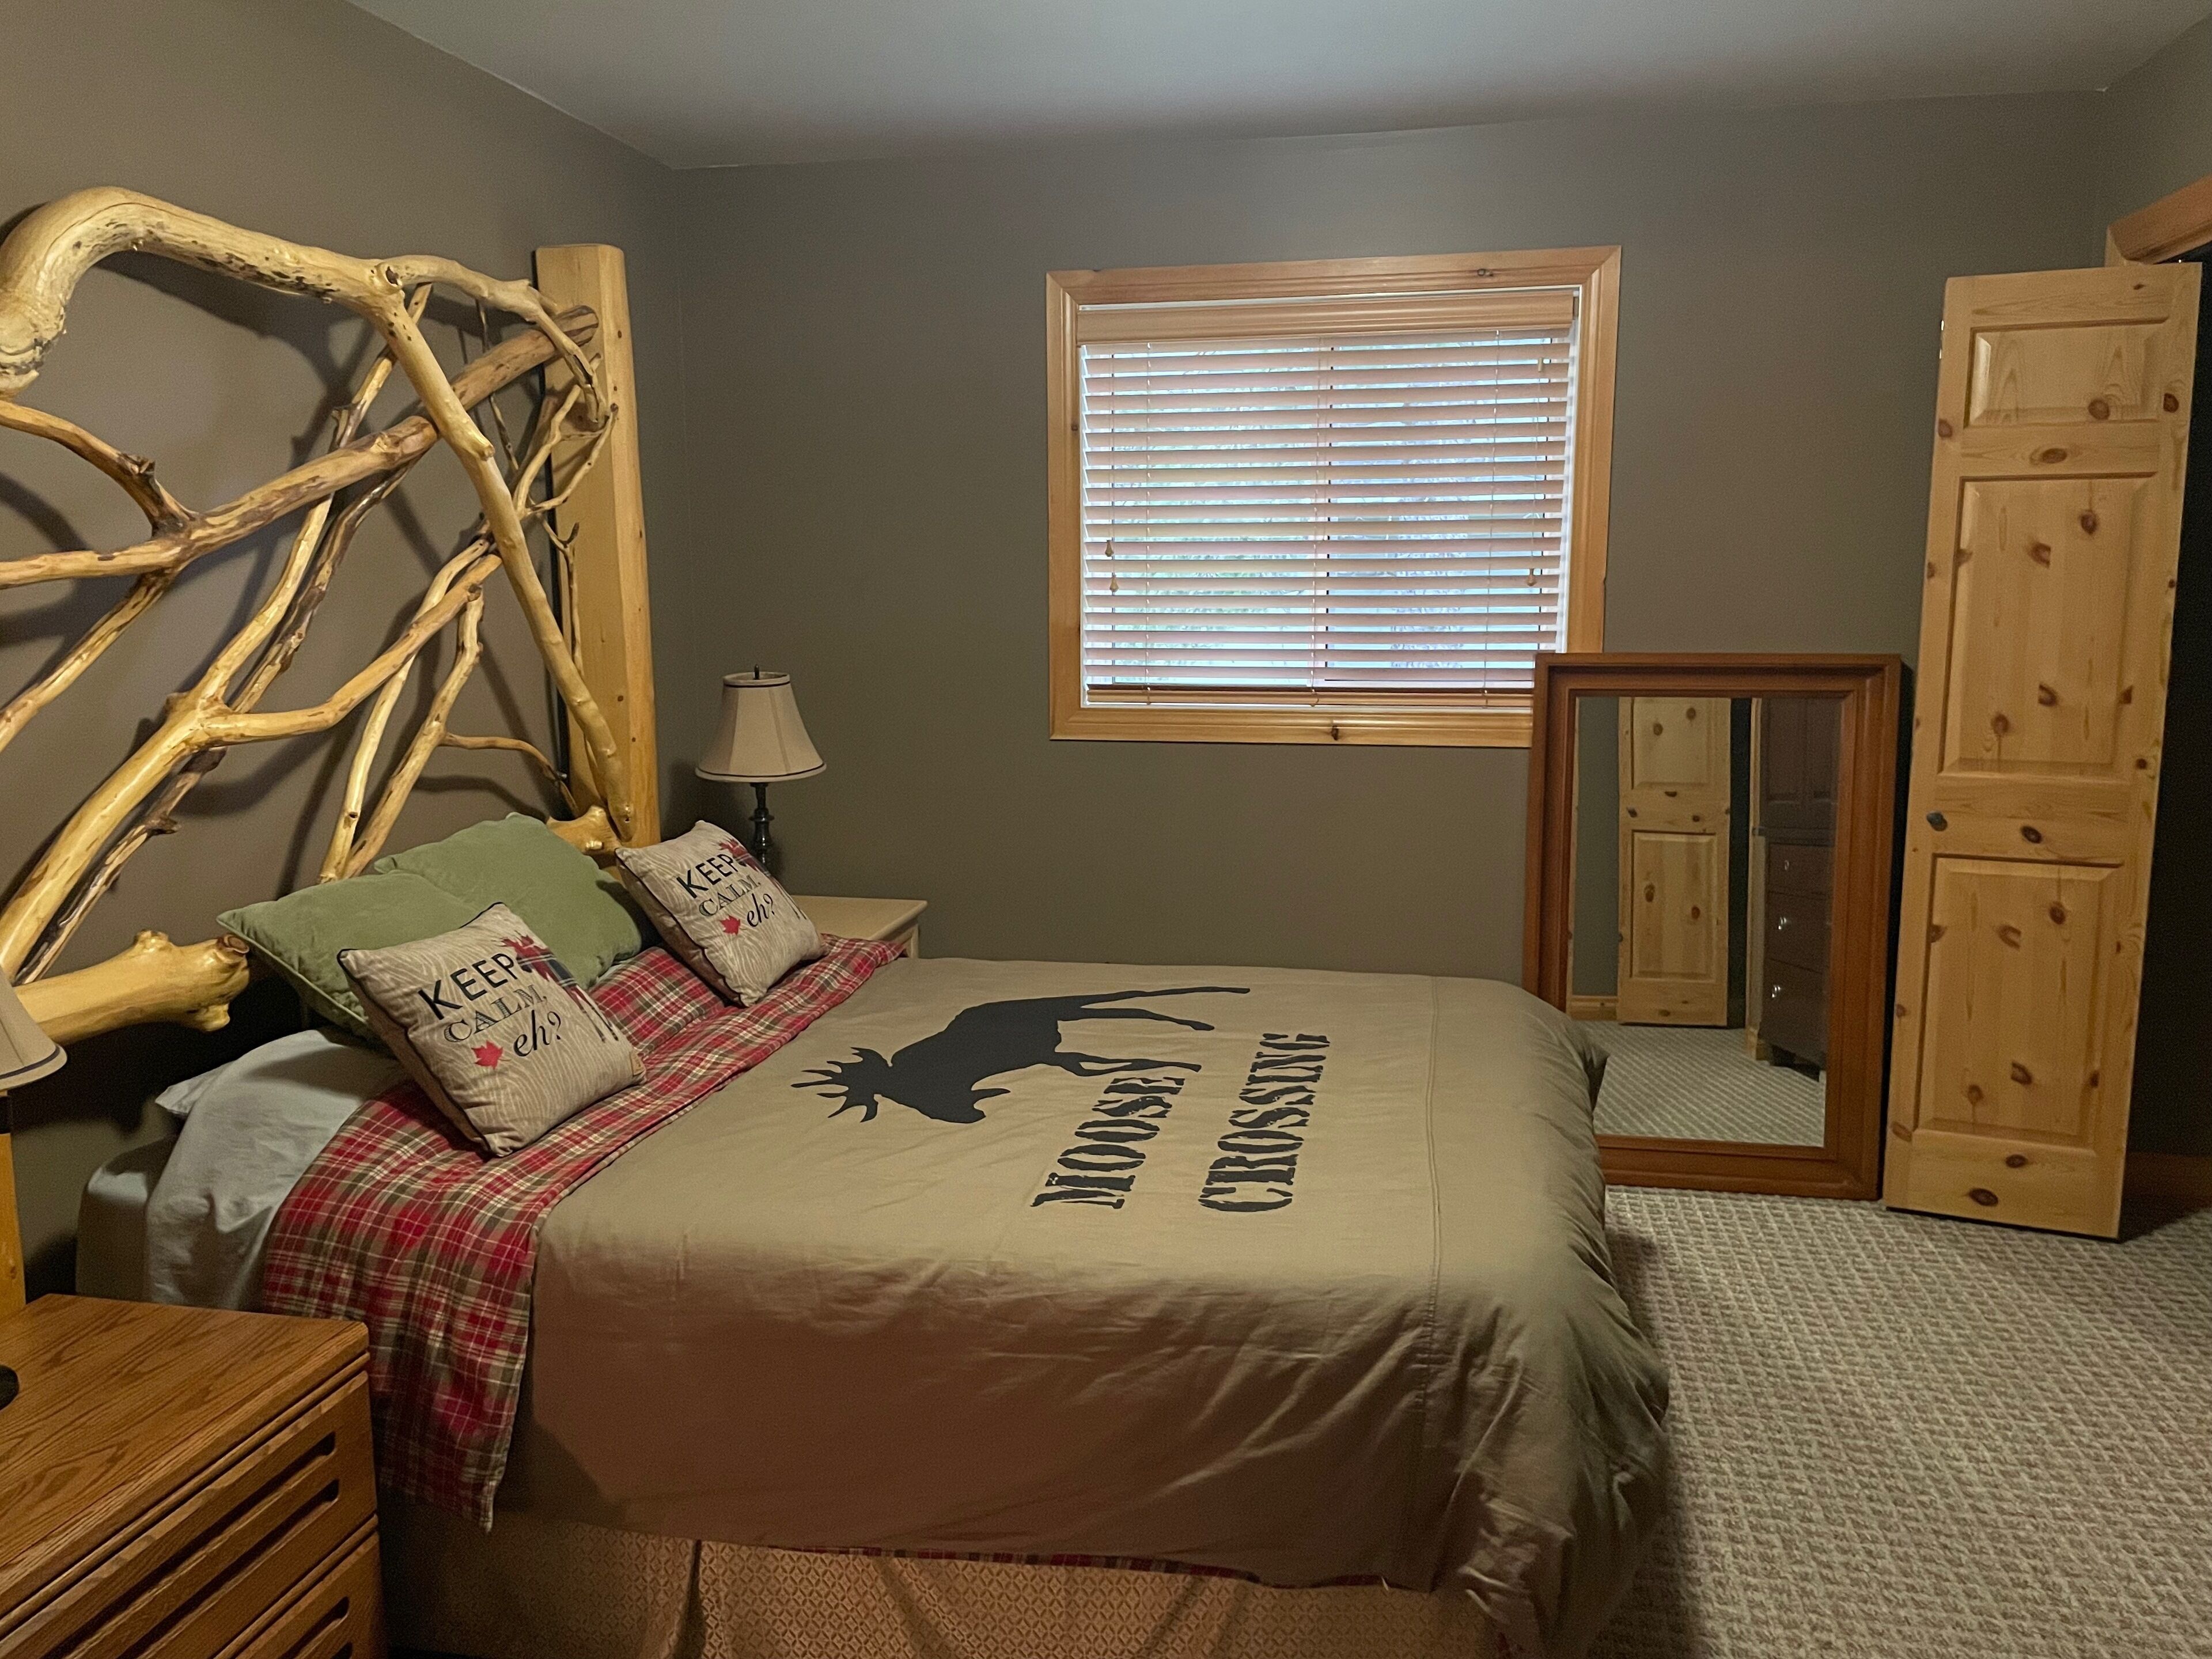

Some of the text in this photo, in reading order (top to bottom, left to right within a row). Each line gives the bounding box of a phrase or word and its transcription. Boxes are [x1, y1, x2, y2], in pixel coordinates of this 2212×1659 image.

[676, 854, 739, 899] KEEP
[747, 893, 775, 927] eh?
[418, 953, 518, 1020] KEEP
[513, 1009, 562, 1057] eh?
[1030, 1076, 1185, 1210] MOOSE
[1198, 1032, 1331, 1213] CROSSING
